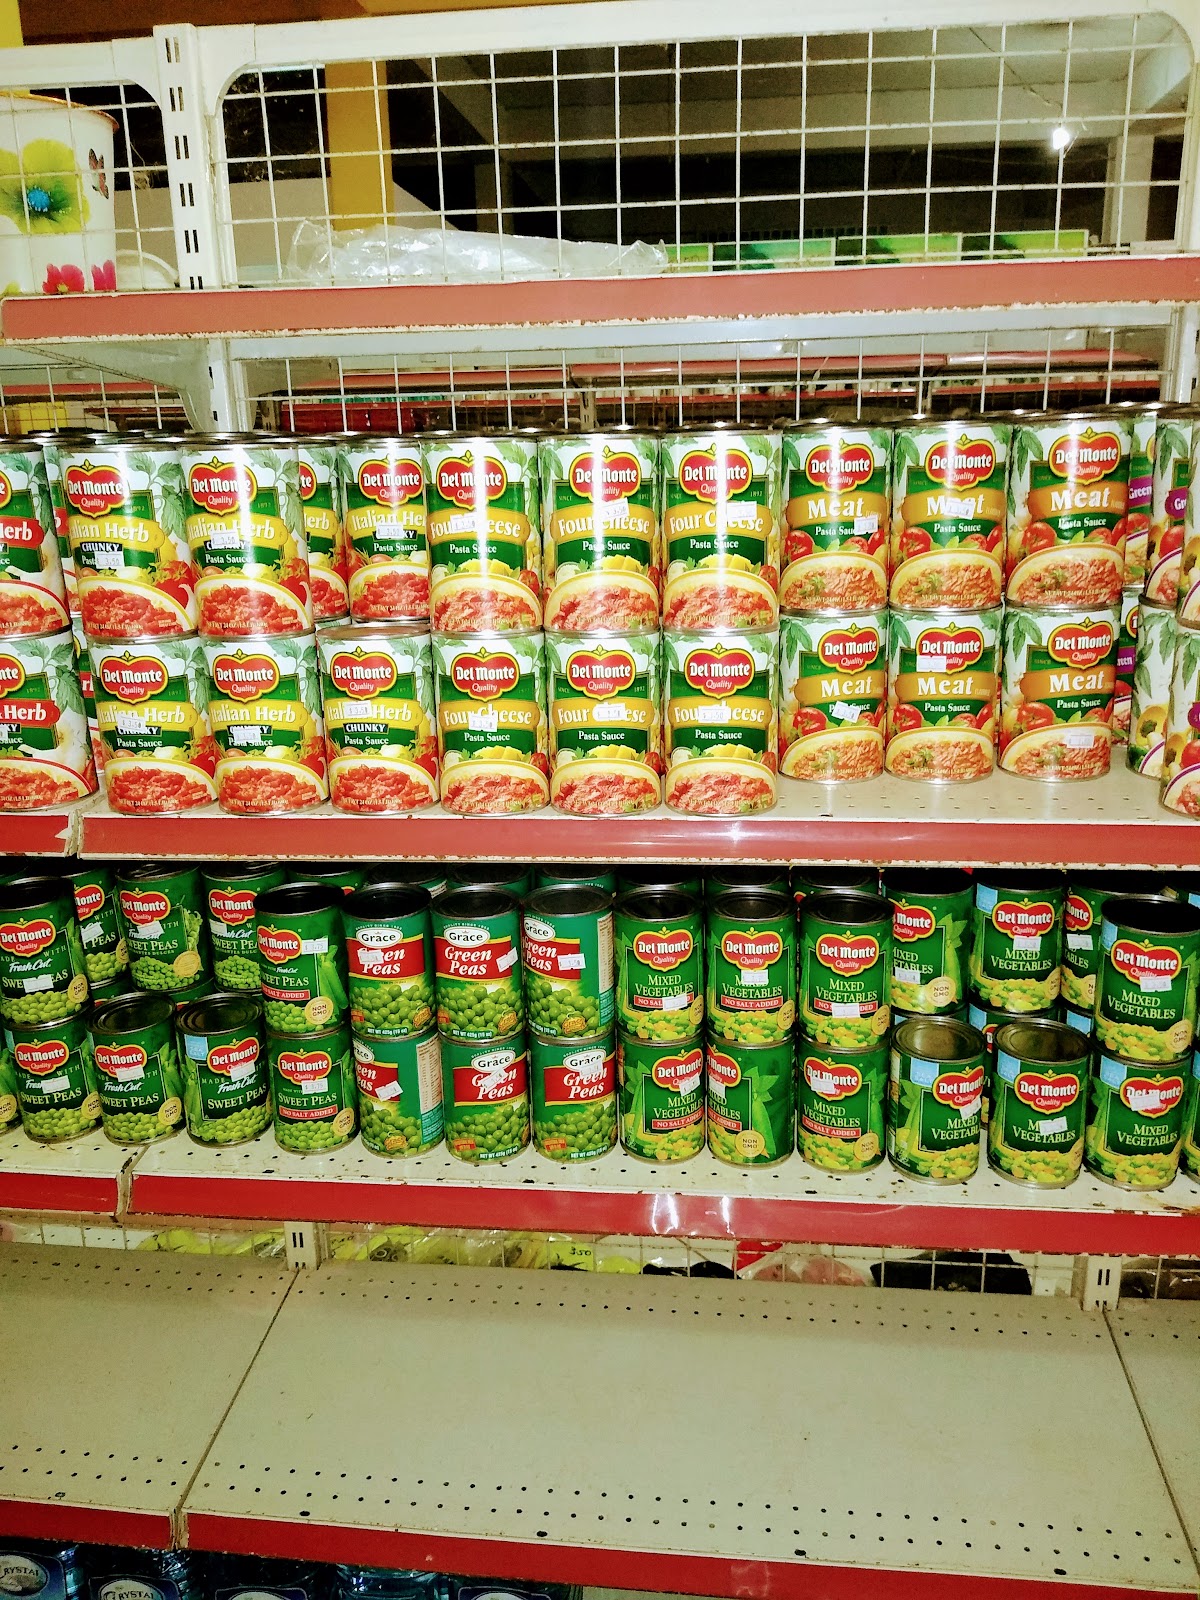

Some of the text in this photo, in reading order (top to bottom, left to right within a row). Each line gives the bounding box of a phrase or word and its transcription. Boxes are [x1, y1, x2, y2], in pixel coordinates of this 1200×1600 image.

[953, 454, 992, 468] Monte
[1078, 448, 1117, 461] Monte
[363, 474, 383, 486] Del
[441, 474, 458, 486] Del
[684, 467, 704, 480] Del
[68, 480, 122, 495] Del Monte
[192, 479, 209, 492] Del
[81, 498, 105, 509] Quality
[208, 496, 232, 506] Quality
[1051, 488, 1109, 511] Meat
[808, 498, 863, 519] Meat
[670, 514, 702, 534] Four
[934, 523, 980, 534] Pasta Sauce
[1080, 517, 1106, 527] Sauce
[105, 521, 149, 542] Herb
[82, 543, 120, 552] CHUNKY
[374, 543, 418, 552] Pasta Sauce
[450, 544, 470, 553] Pasta
[607, 542, 630, 550] Sauce
[690, 540, 711, 549] Pasta
[206, 554, 224, 563] Pasta
[824, 640, 876, 655] Del Monte
[921, 638, 980, 654] Del Monte
[1055, 634, 1111, 651] Del Monte
[841, 658, 863, 666] Quality
[1072, 652, 1096, 661] Quality
[103, 668, 162, 683] Del Monte
[217, 666, 273, 682] Del Monte
[335, 664, 391, 679] Del Monte
[456, 666, 514, 680] Del Monte
[572, 663, 630, 678] Del Monte
[690, 662, 750, 677] Del Monte
[232, 684, 256, 693] Quality
[350, 681, 374, 692] Quality
[472, 682, 497, 693] Quality
[587, 680, 613, 692] Quality
[705, 679, 732, 690] Quality
[821, 676, 872, 697] Meat
[918, 677, 973, 695] Meat
[1049, 671, 1104, 693] Meat
[120, 685, 144, 695] Quality
[925, 702, 970, 712] Pasta Sauce
[1057, 698, 1101, 708] Pasta Sauce
[4, 703, 46, 720] Herb
[257, 706, 295, 723] Herb
[558, 708, 590, 724] Four
[346, 723, 385, 732] CHUNKY
[345, 736, 389, 745] Pasta Sauce
[464, 732, 510, 742] Pasta Sauce
[578, 731, 625, 740] Pasta Sauce
[695, 730, 742, 739] Pasta Sauce
[118, 738, 162, 748] Pasta Sauce
[133, 900, 165, 912] Monte
[997, 911, 1051, 924] Del Monte
[1, 927, 51, 942] Del Monte
[361, 932, 396, 942] Grace
[449, 931, 483, 942] Grace
[151, 940, 178, 950] PEAS
[269, 938, 298, 949] Monte
[524, 936, 557, 958] Green
[638, 940, 690, 953] Del Monte
[726, 941, 778, 953] Del Monte
[821, 943, 875, 957] Del Monte
[43, 945, 66, 958] WITH
[445, 946, 492, 962] Green
[9, 959, 30, 972] Fresh
[527, 950, 552, 971] Peas
[990, 956, 1052, 971] VEGETABLES
[1116, 950, 1177, 970] Del Monte
[450, 963, 487, 976] Peas
[283, 976, 309, 986] PEAS
[648, 975, 681, 985] MIXED
[829, 978, 864, 992] MIXED
[722, 985, 782, 996] VEGETABLES
[815, 987, 877, 1002] VEGETABLES
[755, 999, 778, 1007] ADDED
[1121, 989, 1161, 1007] MIXED
[1107, 995, 1176, 1019] VEGETABLES
[18, 1047, 65, 1063] Del Monte
[97, 1051, 143, 1064] Del Monte
[211, 1044, 258, 1066] Del Monte
[477, 1055, 511, 1068] Grace
[56, 1064, 80, 1077] WITH
[281, 1059, 328, 1071] Del Monte
[658, 1068, 671, 1078] Del
[104, 1081, 121, 1092] Fresh
[568, 1083, 604, 1099] Peas
[939, 1083, 954, 1095] Del
[1019, 1081, 1076, 1095] Del Monte
[52, 1087, 82, 1103] PEAS
[131, 1092, 159, 1106] PEAS
[208, 1084, 267, 1109] SWEET PEAS
[278, 1091, 337, 1107] SWEET PEAS
[313, 1107, 333, 1115] ADDED
[813, 1098, 845, 1116] MIXED
[803, 1105, 860, 1127] VEGETABLES
[1013, 1126, 1075, 1143] VEGETABLES
[1133, 1124, 1168, 1135] MIXED
